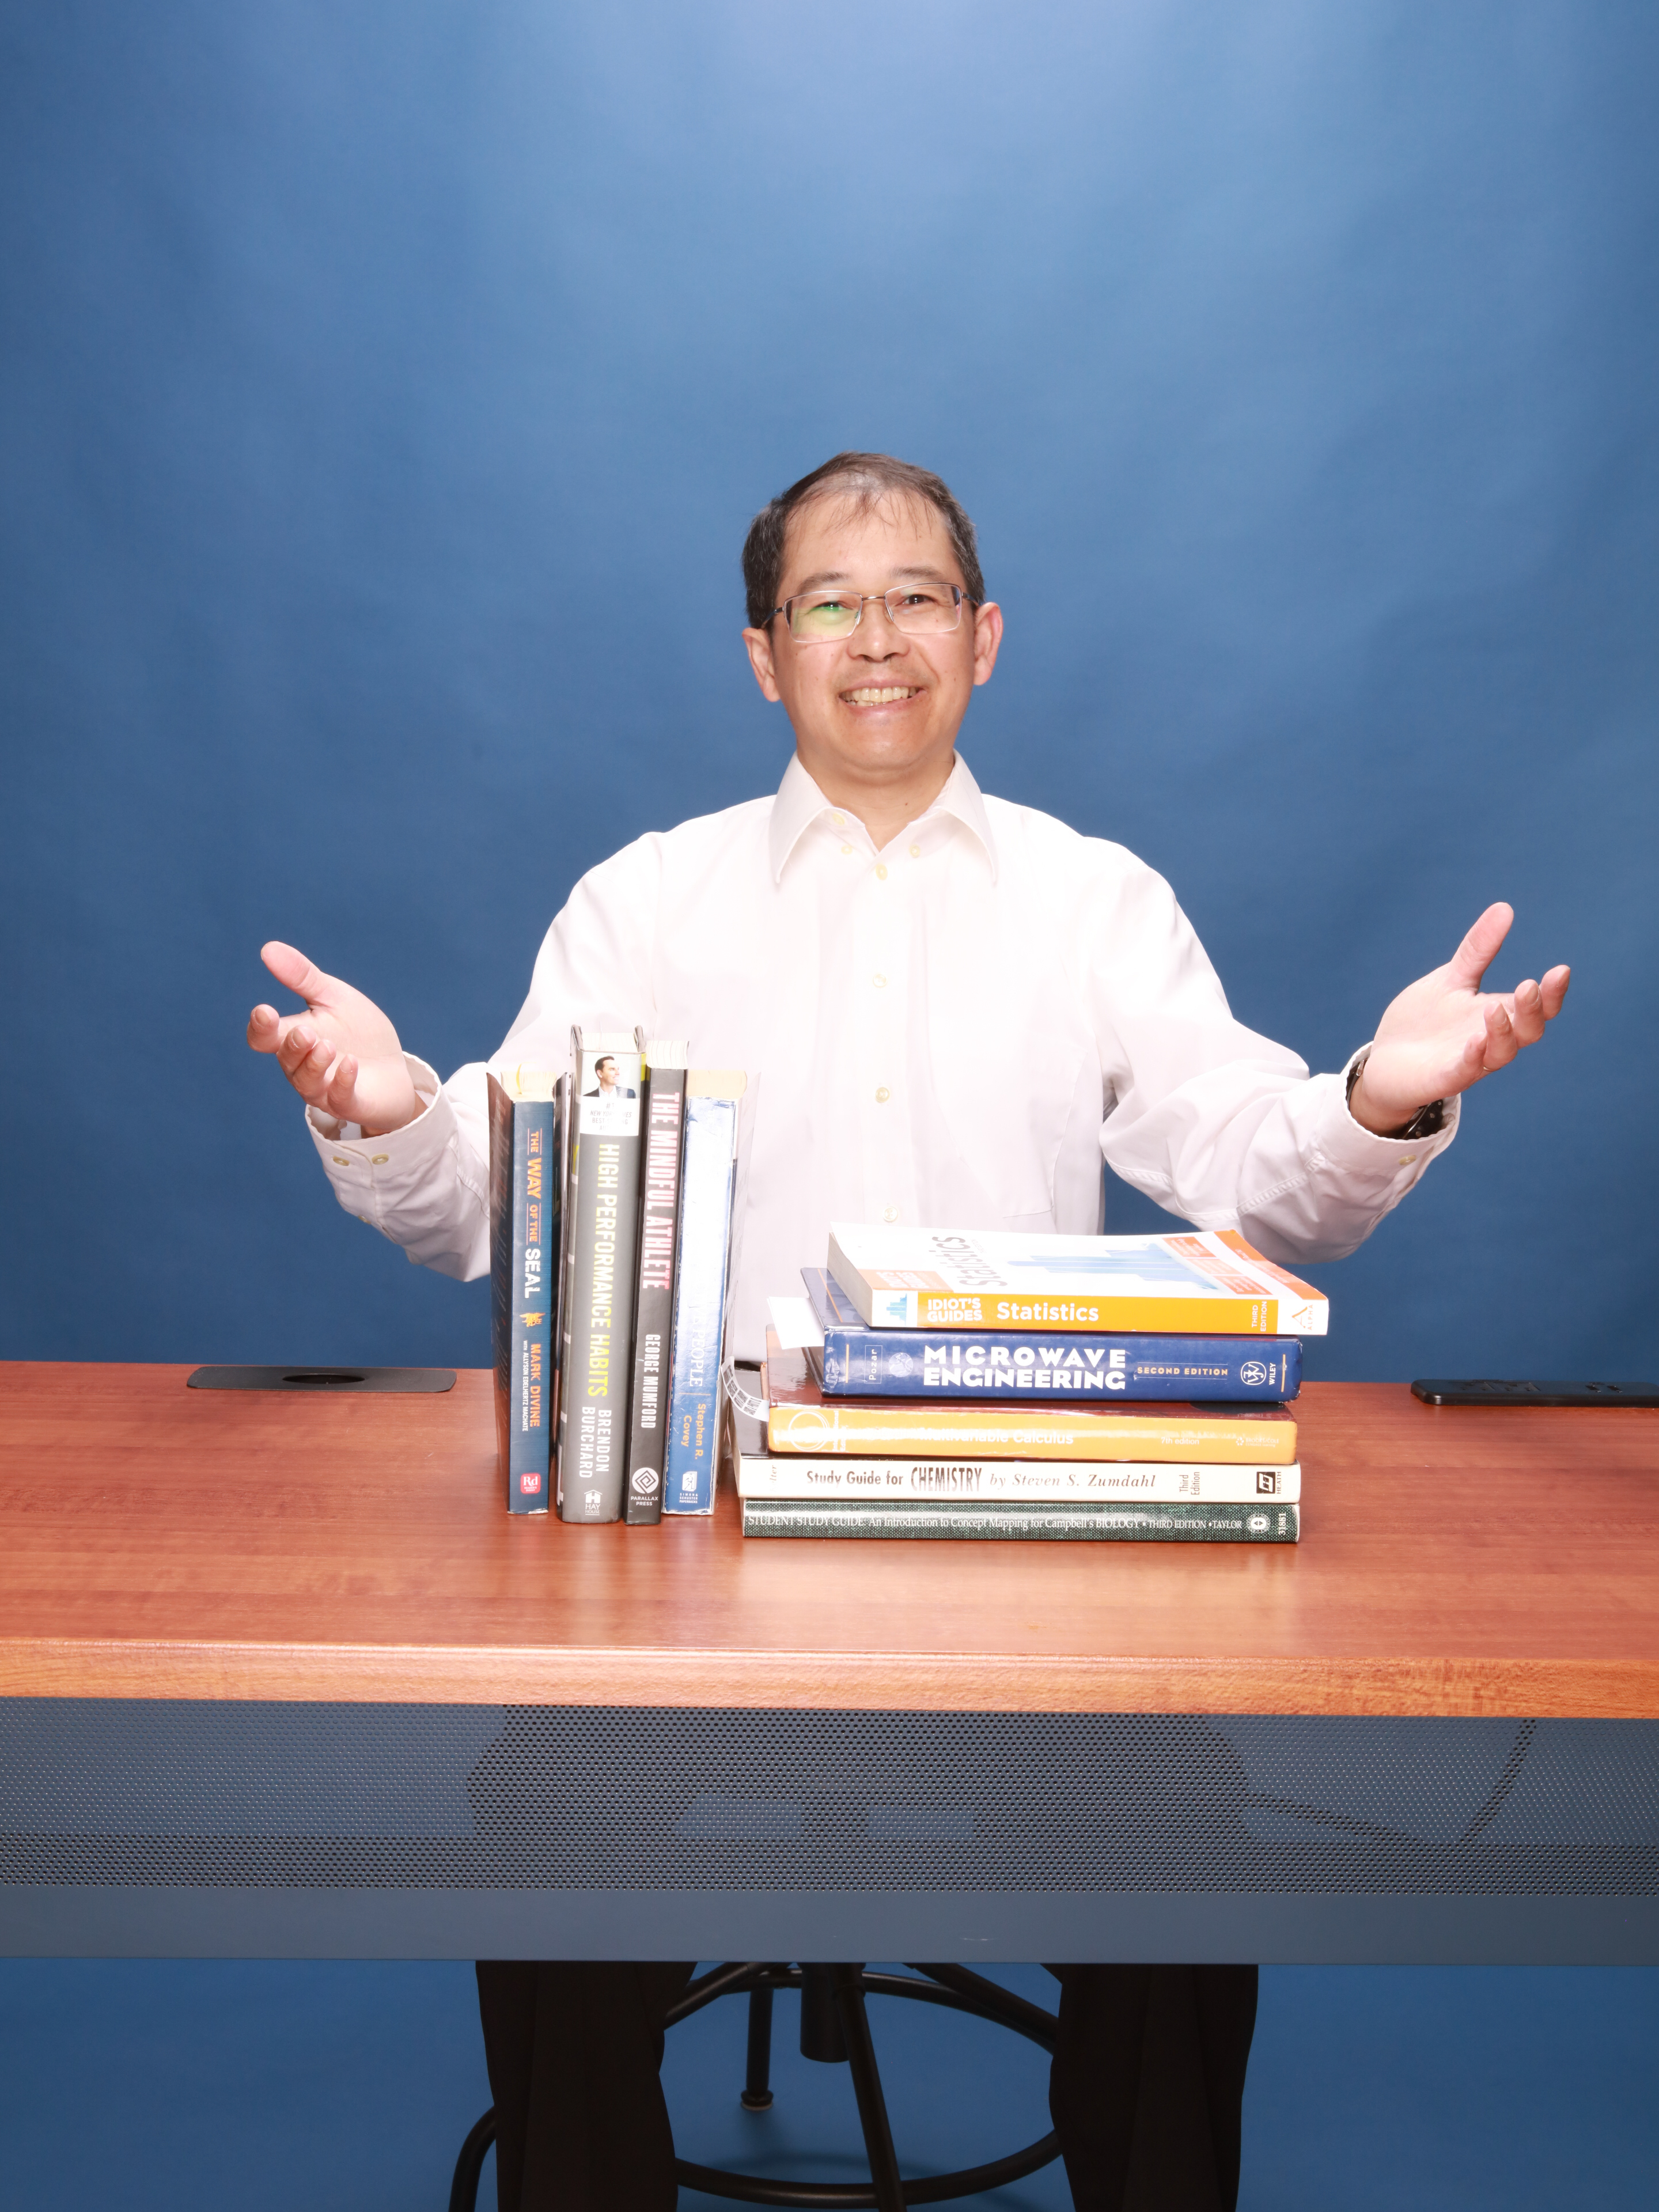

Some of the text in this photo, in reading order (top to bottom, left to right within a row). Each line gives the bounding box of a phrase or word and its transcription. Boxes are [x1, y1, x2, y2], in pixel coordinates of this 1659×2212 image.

[597, 1143, 620, 1188] HIGH
[642, 1092, 680, 1290] THE MINDFUL ATHLETE
[525, 1131, 541, 1298] THE WAY OF THE SEAL
[591, 1194, 618, 1328] PERFORMANCE
[929, 1236, 1008, 1287] Statistics
[927, 1309, 983, 1322] GUIDES
[928, 1297, 981, 1310] IDIOT'S
[997, 1301, 1099, 1321] Statistics
[588, 1334, 610, 1397] HABITS
[689, 1329, 706, 1387] PEOPLE
[869, 1349, 877, 1380] Pozar
[924, 1345, 1126, 1368] MICROWAVE
[1137, 1366, 1228, 1376] SECOND EDITION
[529, 1343, 541, 1427] MARK DIVINE
[641, 1334, 661, 1429] GEORGE MUMFORD
[923, 1367, 1126, 1390] ENGINEERING
[579, 1407, 596, 1478] BURCHARD
[596, 1409, 612, 1472] BRENDON
[680, 1415, 692, 1448] Covey
[695, 1403, 706, 1460] Stephen R.
[1013, 1430, 1074, 1444] Calculus
[523, 1476, 538, 1486] Rd
[806, 1467, 1156, 1492] Study Guide for CHEMISTRY by Steven S. Zumdahl
[1179, 1475, 1188, 1492] Third
[1190, 1472, 1200, 1495] Edition
[748, 1516, 794, 1525] STUDENT
[797, 1516, 829, 1526] STUDY
[868, 1516, 882, 1526] An
[884, 1517, 938, 1527] Introduction
[941, 1517, 949, 1527] to
[950, 1517, 987, 1530] Concept
[989, 1517, 1028, 1531] Mapping
[1031, 1517, 1043, 1528] for
[1096, 1518, 1140, 1528] BIOLOGY
[1149, 1520, 1173, 1528] THIRD
[1174, 1520, 1206, 1528] EDITION
[1214, 1520, 1243, 1529] TAYLOR
[1278, 1513, 1286, 1536] 31881
